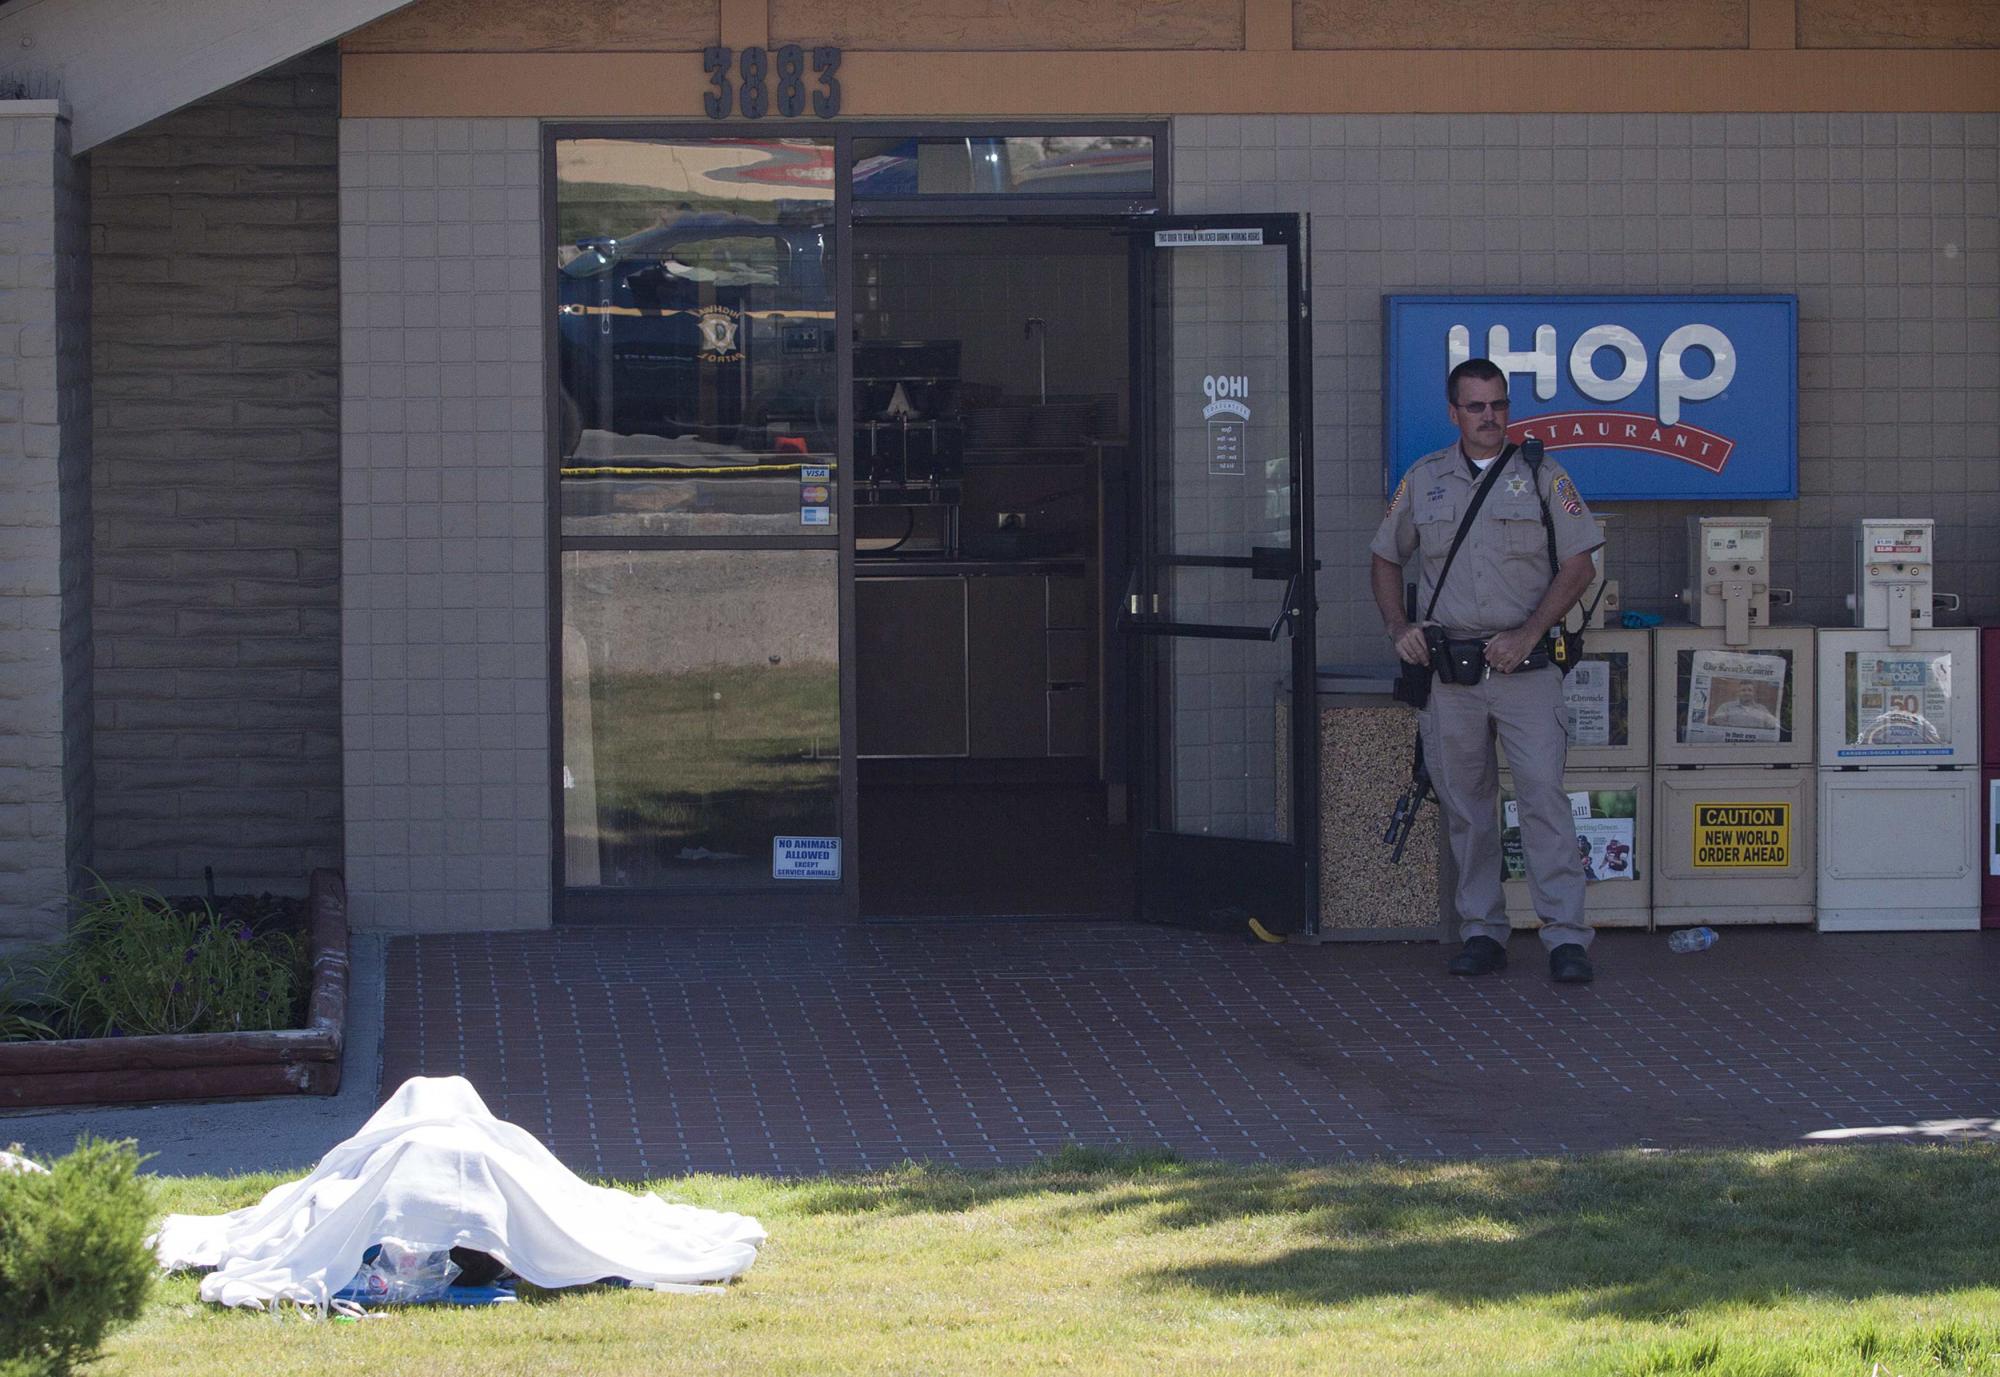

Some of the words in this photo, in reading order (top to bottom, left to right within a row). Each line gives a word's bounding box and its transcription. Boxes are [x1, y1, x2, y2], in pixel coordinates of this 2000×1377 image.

[703, 45, 841, 119] 3883
[1522, 422, 1713, 456] STAURANT
[1898, 663, 1919, 673] USA
[1888, 672, 1921, 683] TODAY
[1890, 694, 1919, 714] 50
[1706, 809, 1775, 825] CAUTION
[778, 839, 793, 849] NO
[794, 840, 838, 849] ANIMALS
[1705, 830, 1733, 846] NEW
[1736, 830, 1779, 846] WORLD
[785, 850, 830, 860] ALLOWED
[1699, 847, 1741, 862] ORDER
[1743, 847, 1784, 862] AHEAD
